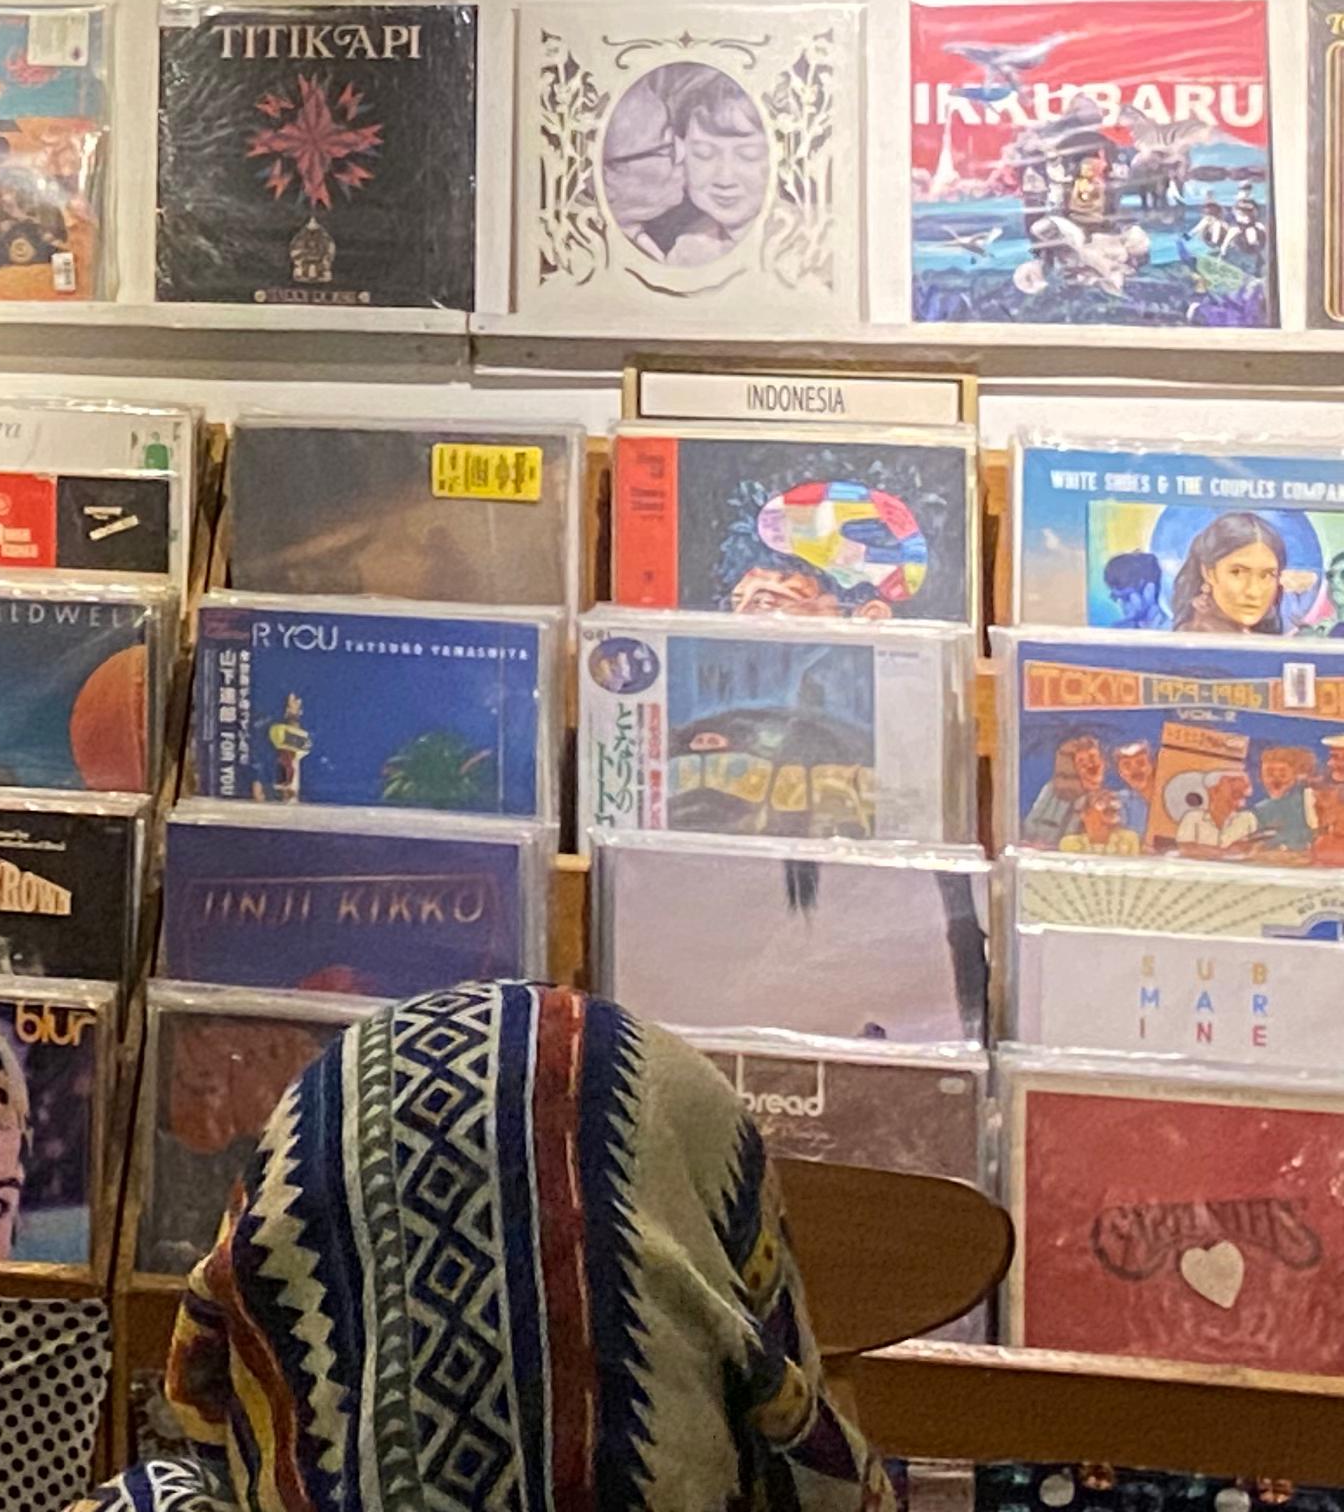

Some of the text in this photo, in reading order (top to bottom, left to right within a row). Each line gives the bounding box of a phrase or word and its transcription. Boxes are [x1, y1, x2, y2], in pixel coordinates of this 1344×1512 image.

[211, 24, 335, 59] TITIK
[747, 384, 846, 413] INDONESIA
[1050, 470, 1097, 491] WHITE
[1105, 473, 1151, 494] SHOES
[1176, 476, 1203, 496] THE
[1210, 479, 1277, 500] COUPLES
[277, 624, 339, 651] YOU
[218, 765, 236, 796] YOU
[735, 1055, 824, 1118] bread
